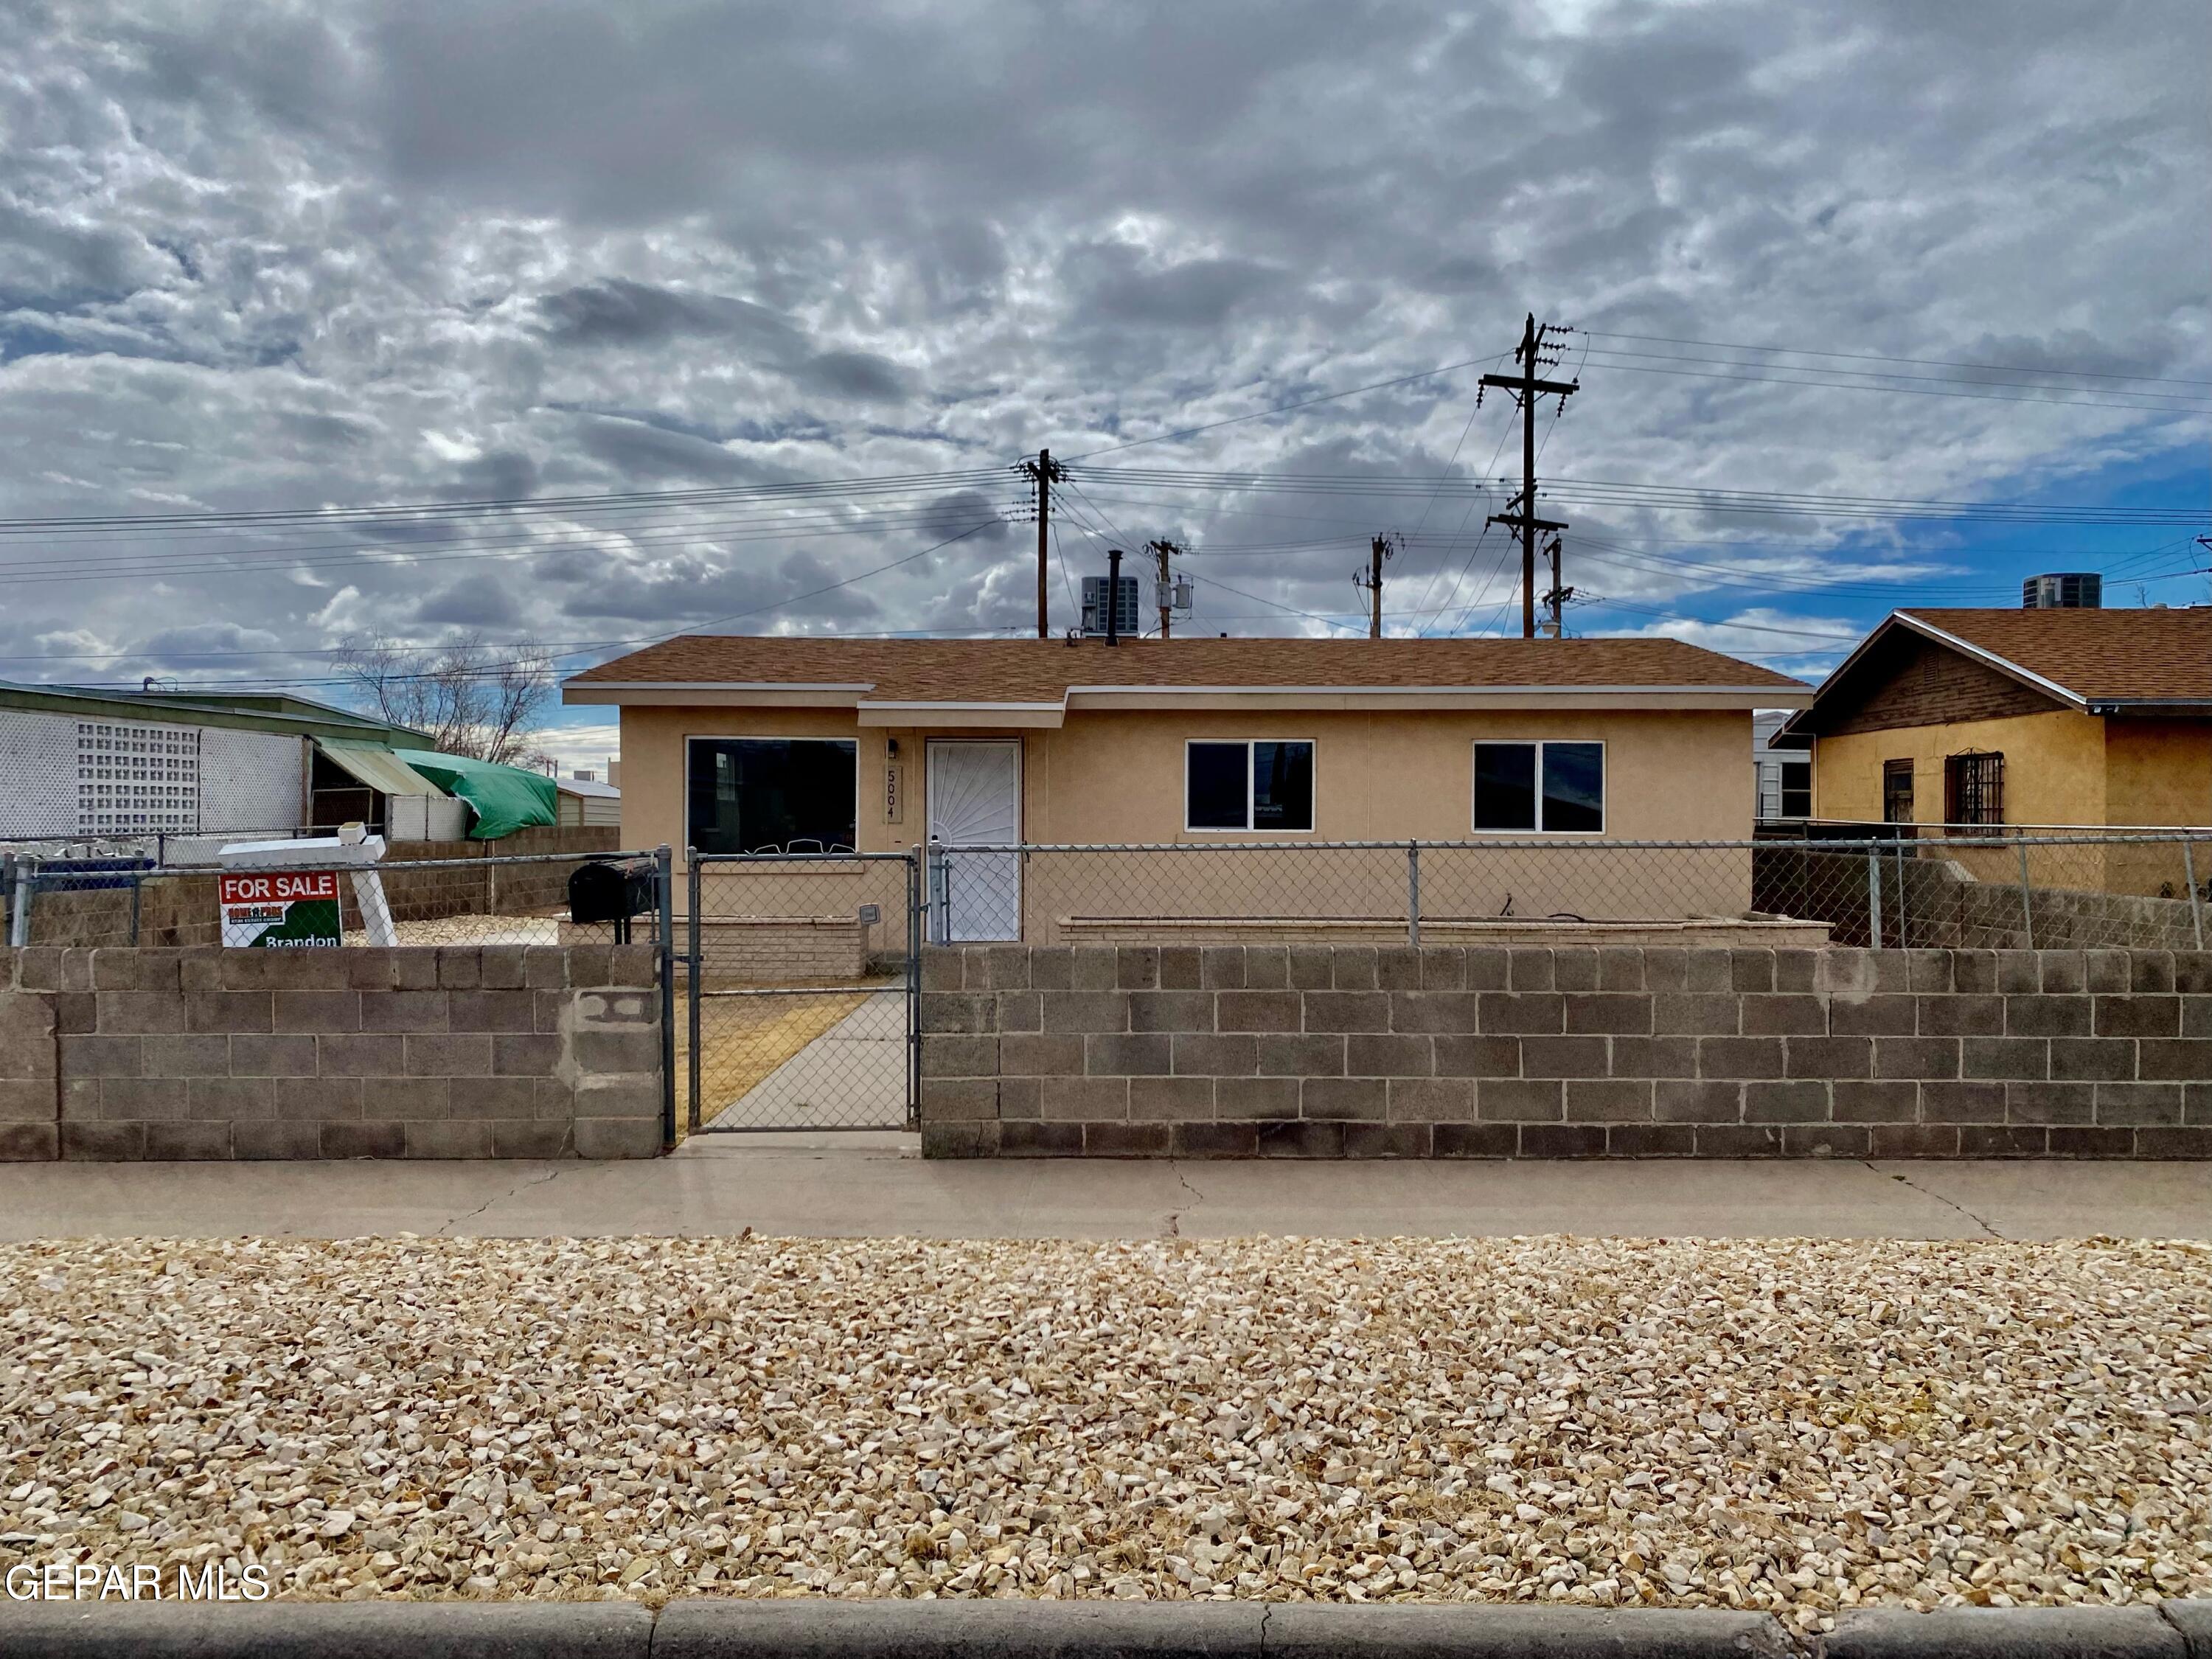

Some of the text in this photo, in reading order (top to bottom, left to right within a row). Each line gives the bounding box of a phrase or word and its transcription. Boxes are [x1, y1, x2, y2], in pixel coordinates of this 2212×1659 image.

[225, 876, 333, 900] FOR SALE
[266, 934, 337, 947] Brandon
